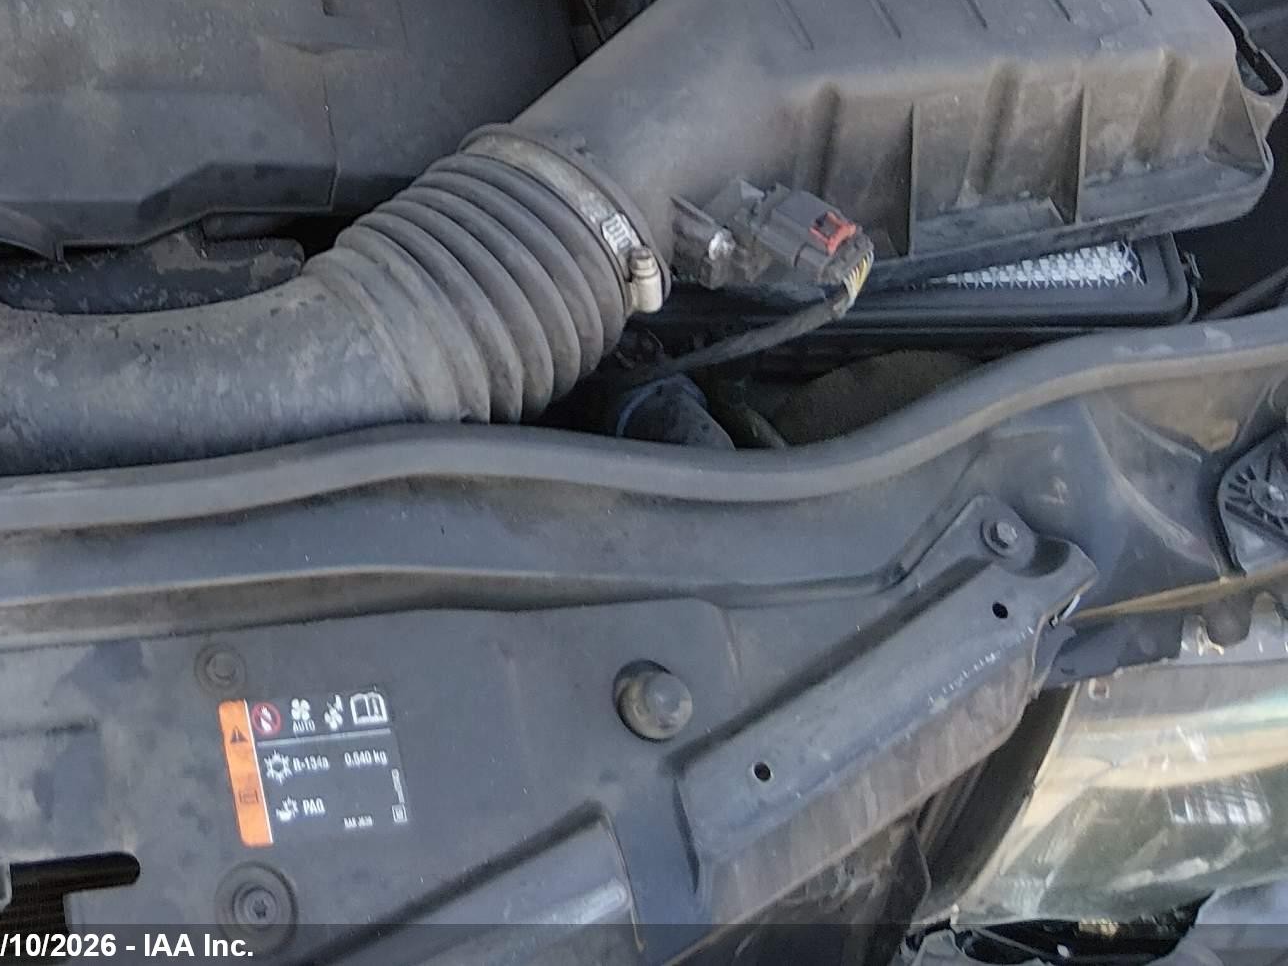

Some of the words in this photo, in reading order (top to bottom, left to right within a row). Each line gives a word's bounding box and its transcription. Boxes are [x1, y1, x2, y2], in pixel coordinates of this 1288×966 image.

[292, 720, 316, 732] AUTO
[292, 755, 329, 772] R-134a
[372, 748, 388, 766] kg
